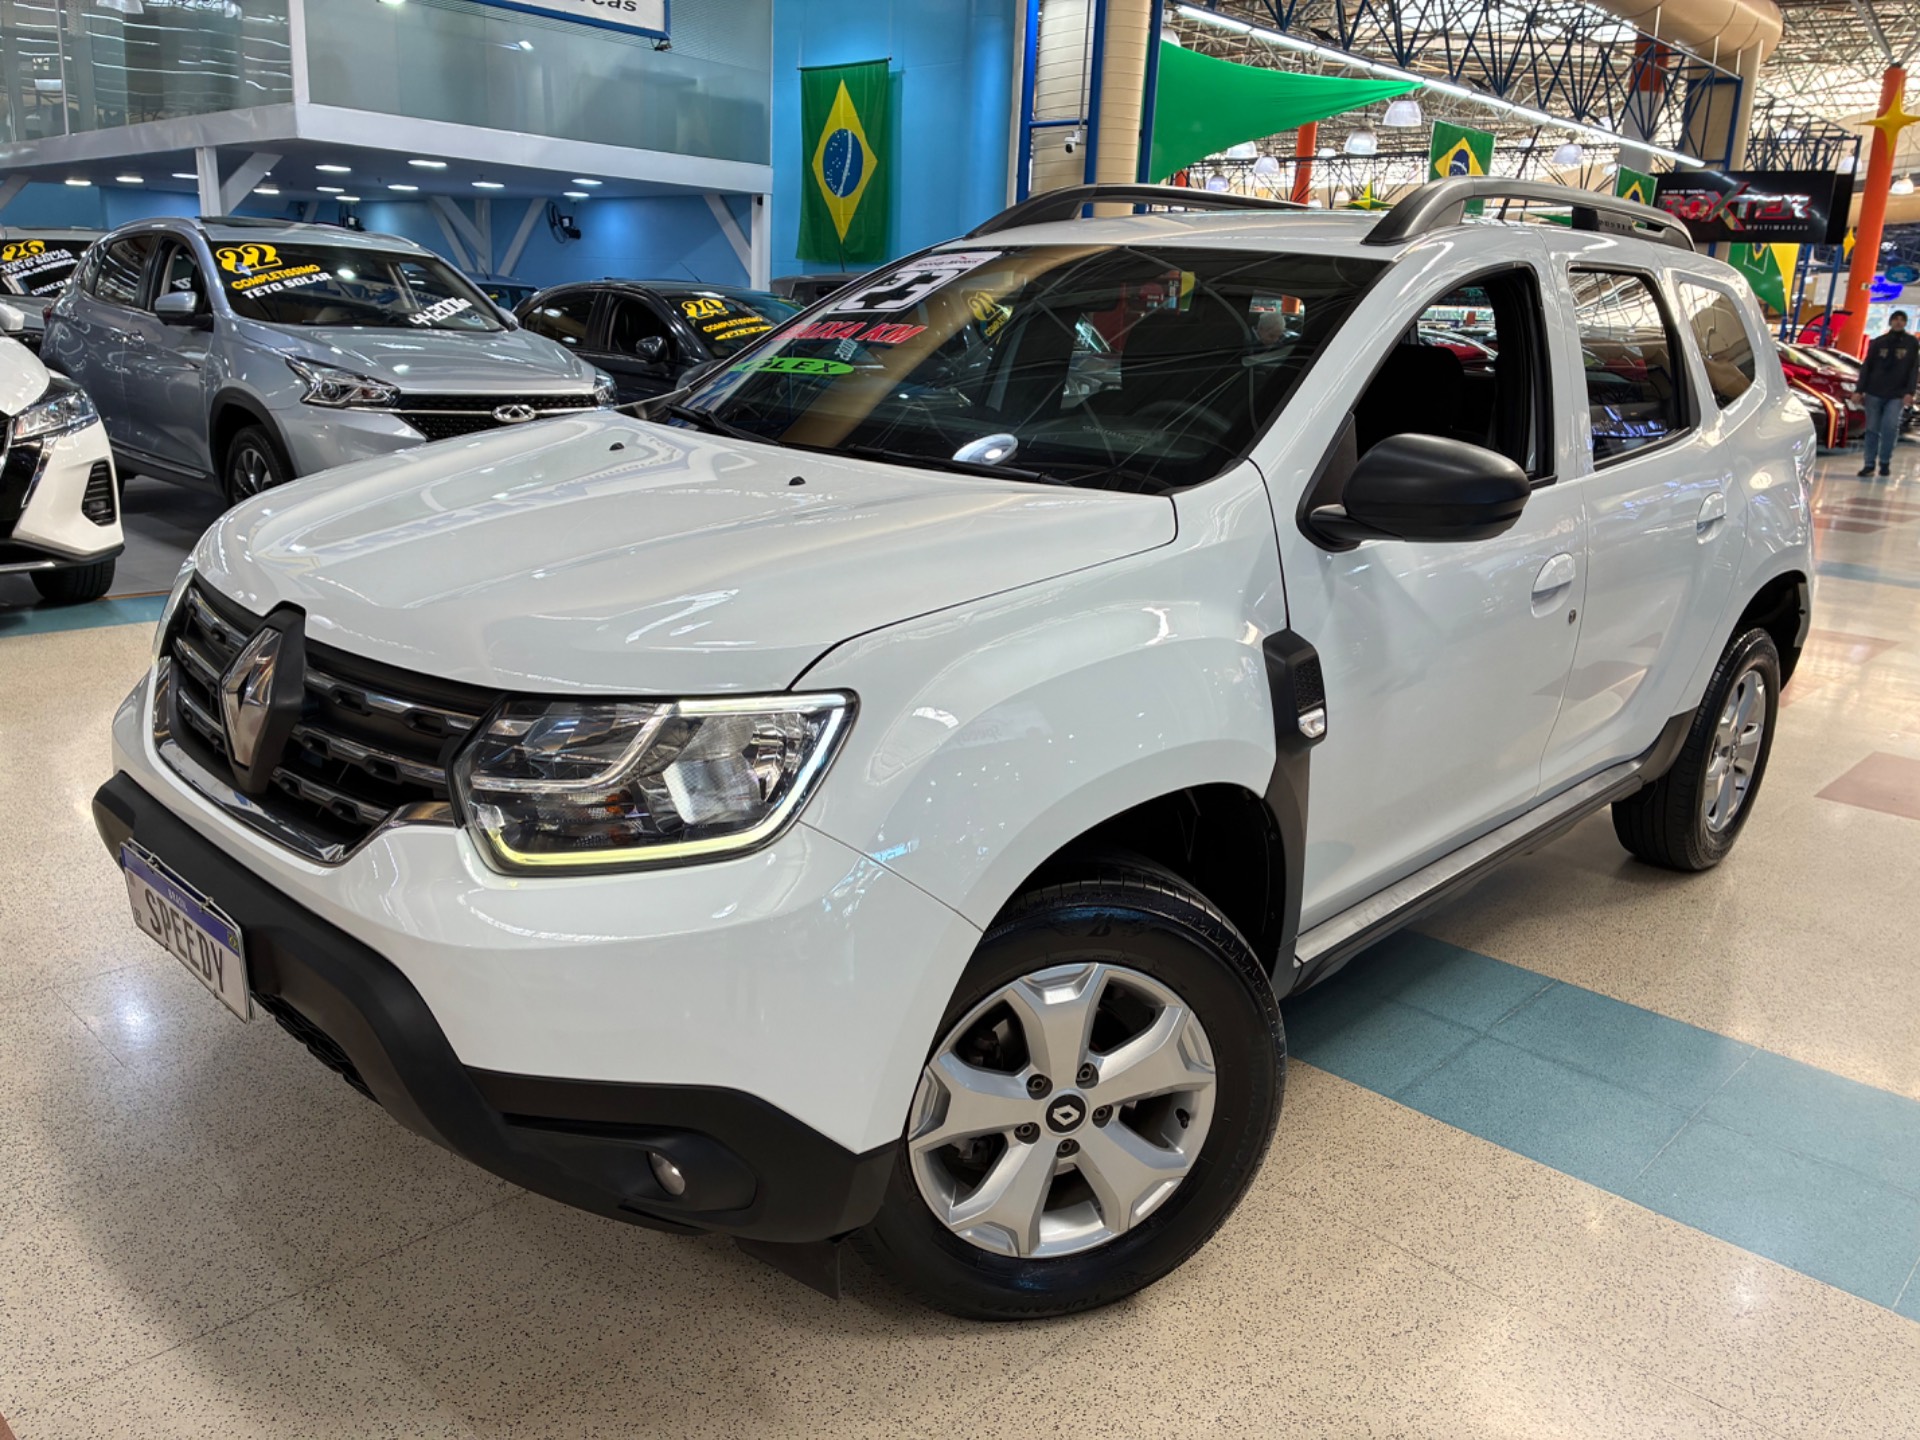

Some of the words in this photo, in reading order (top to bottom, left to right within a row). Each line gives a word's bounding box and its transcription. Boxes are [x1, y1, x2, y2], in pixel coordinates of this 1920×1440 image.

[1658, 182, 1812, 231] BOXTER
[1745, 223, 1809, 232] MULTIMARCAS
[2, 239, 46, 262] 26
[216, 243, 283, 274] 22
[242, 281, 284, 299] TETO
[283, 272, 333, 290] SOLAR
[144, 888, 225, 994] SPEEDY
